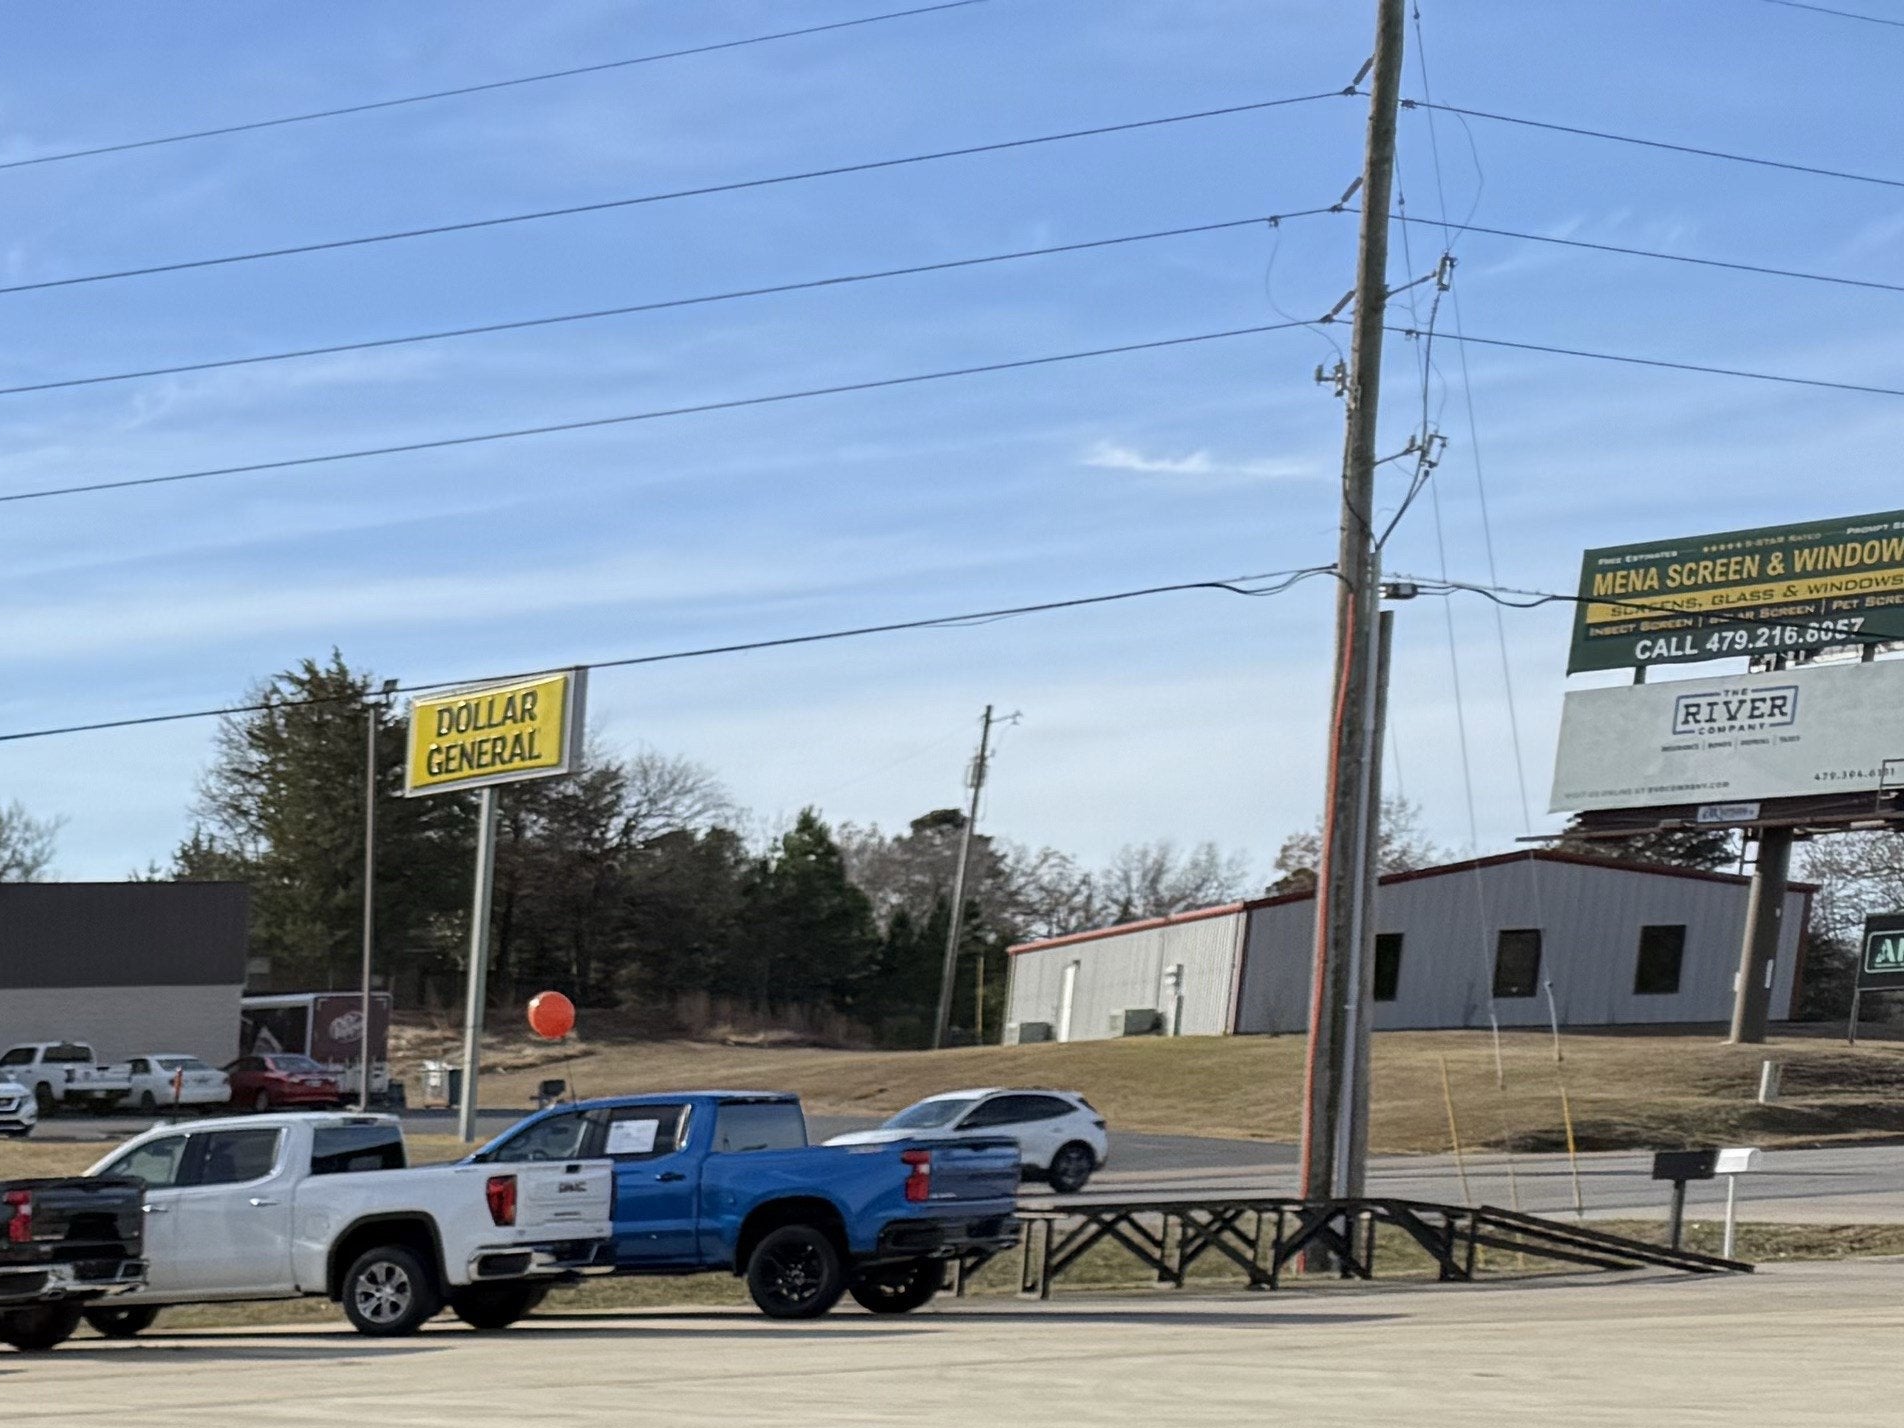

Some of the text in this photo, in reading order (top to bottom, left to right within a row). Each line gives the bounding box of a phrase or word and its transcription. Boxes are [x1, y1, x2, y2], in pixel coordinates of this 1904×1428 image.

[1593, 567, 1660, 597] MENA
[1666, 554, 1760, 588] SCREEN
[1767, 552, 1785, 576] &
[1711, 589, 1774, 606] GLASS
[1783, 585, 1798, 598] &
[1808, 574, 1904, 595] WINDOWS
[1635, 617, 1866, 660] CALL 479.216.8057
[1681, 695, 1788, 725] RIVER
[1723, 688, 1749, 697] THE
[437, 690, 538, 738] DOLLAR
[1698, 723, 1766, 735] COMPANY
[427, 728, 542, 776] GENERAL
